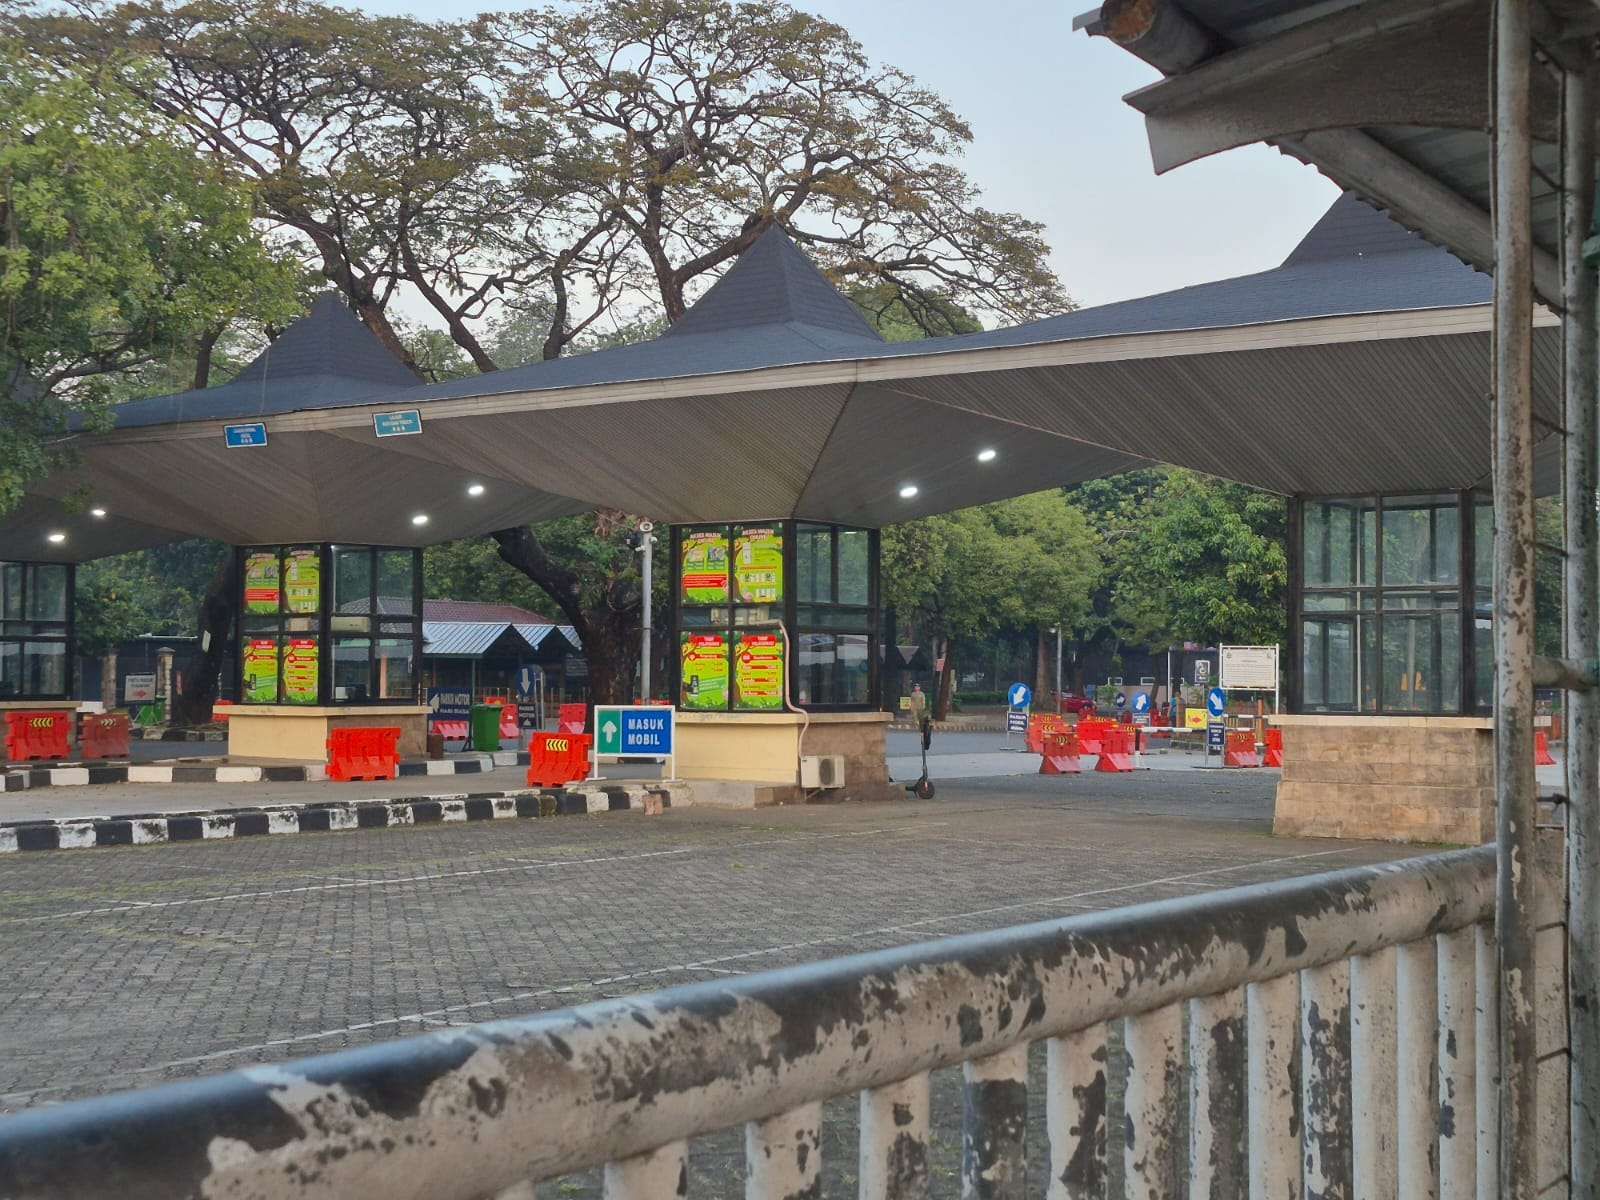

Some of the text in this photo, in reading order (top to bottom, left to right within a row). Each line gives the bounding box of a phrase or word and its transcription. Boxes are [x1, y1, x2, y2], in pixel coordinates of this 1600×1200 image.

[454, 693, 470, 705] MOTOR
[627, 718, 664, 730] MASUK
[627, 733, 660, 745] MOBIL
